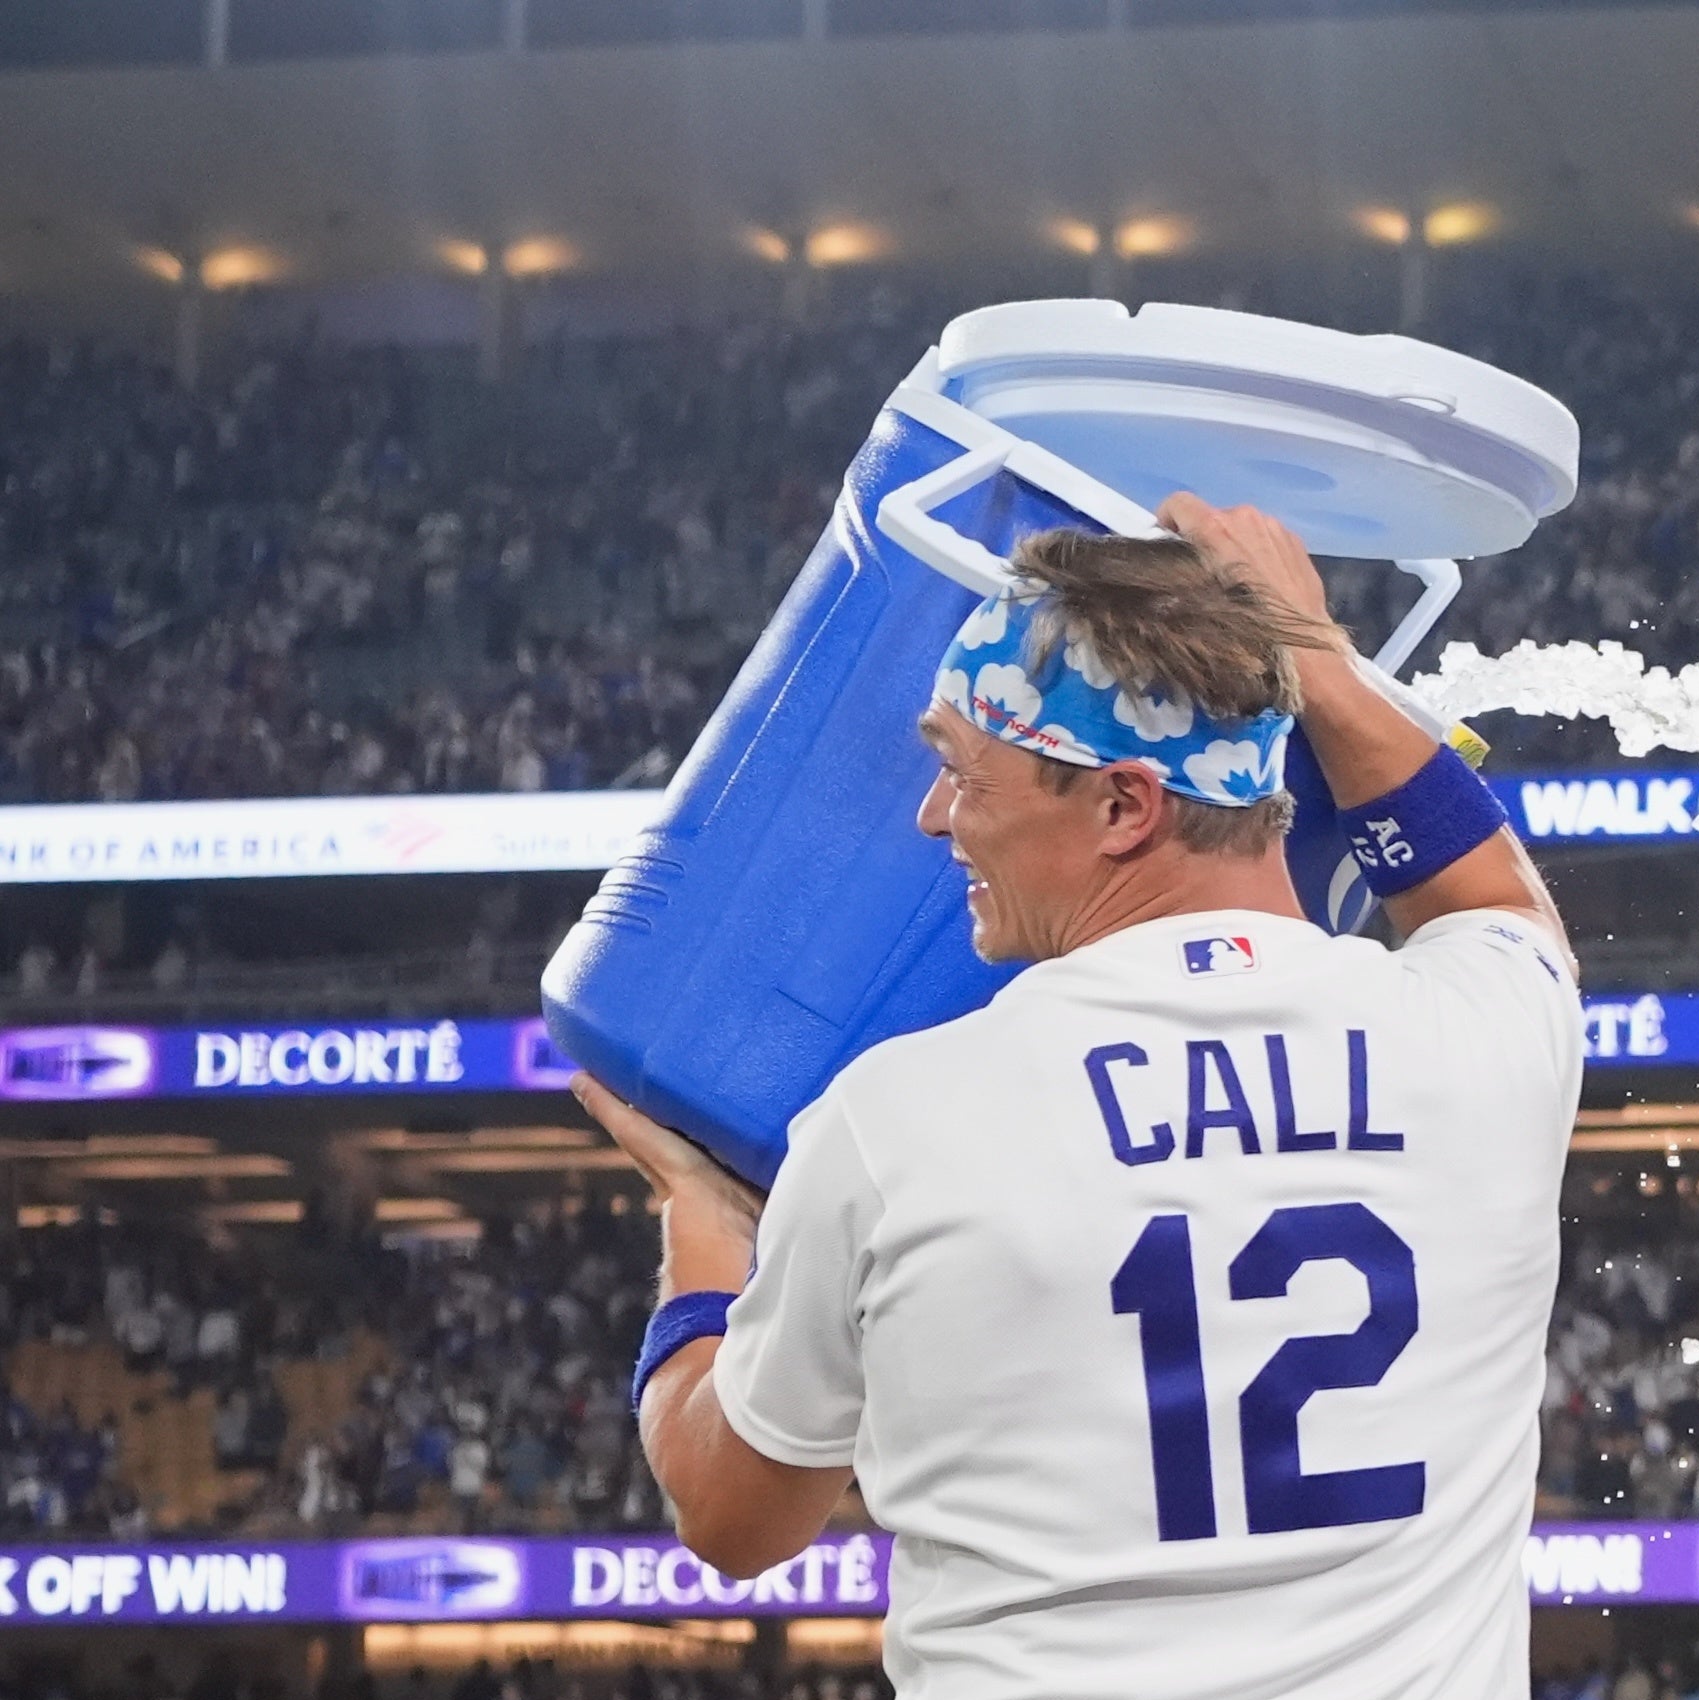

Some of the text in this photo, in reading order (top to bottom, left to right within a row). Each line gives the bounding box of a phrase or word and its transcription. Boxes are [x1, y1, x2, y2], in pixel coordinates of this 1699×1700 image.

[1521, 779, 1694, 836] WALK
[70, 838, 122, 866] OF
[138, 833, 343, 864] AMERICA
[1365, 816, 1414, 868] AC
[195, 1021, 464, 1088] DECORTÉ
[1083, 1029, 1405, 1167] CALL
[1110, 1202, 1427, 1542] 12
[27, 1555, 142, 1615] OFF
[148, 1552, 287, 1614] WIN!
